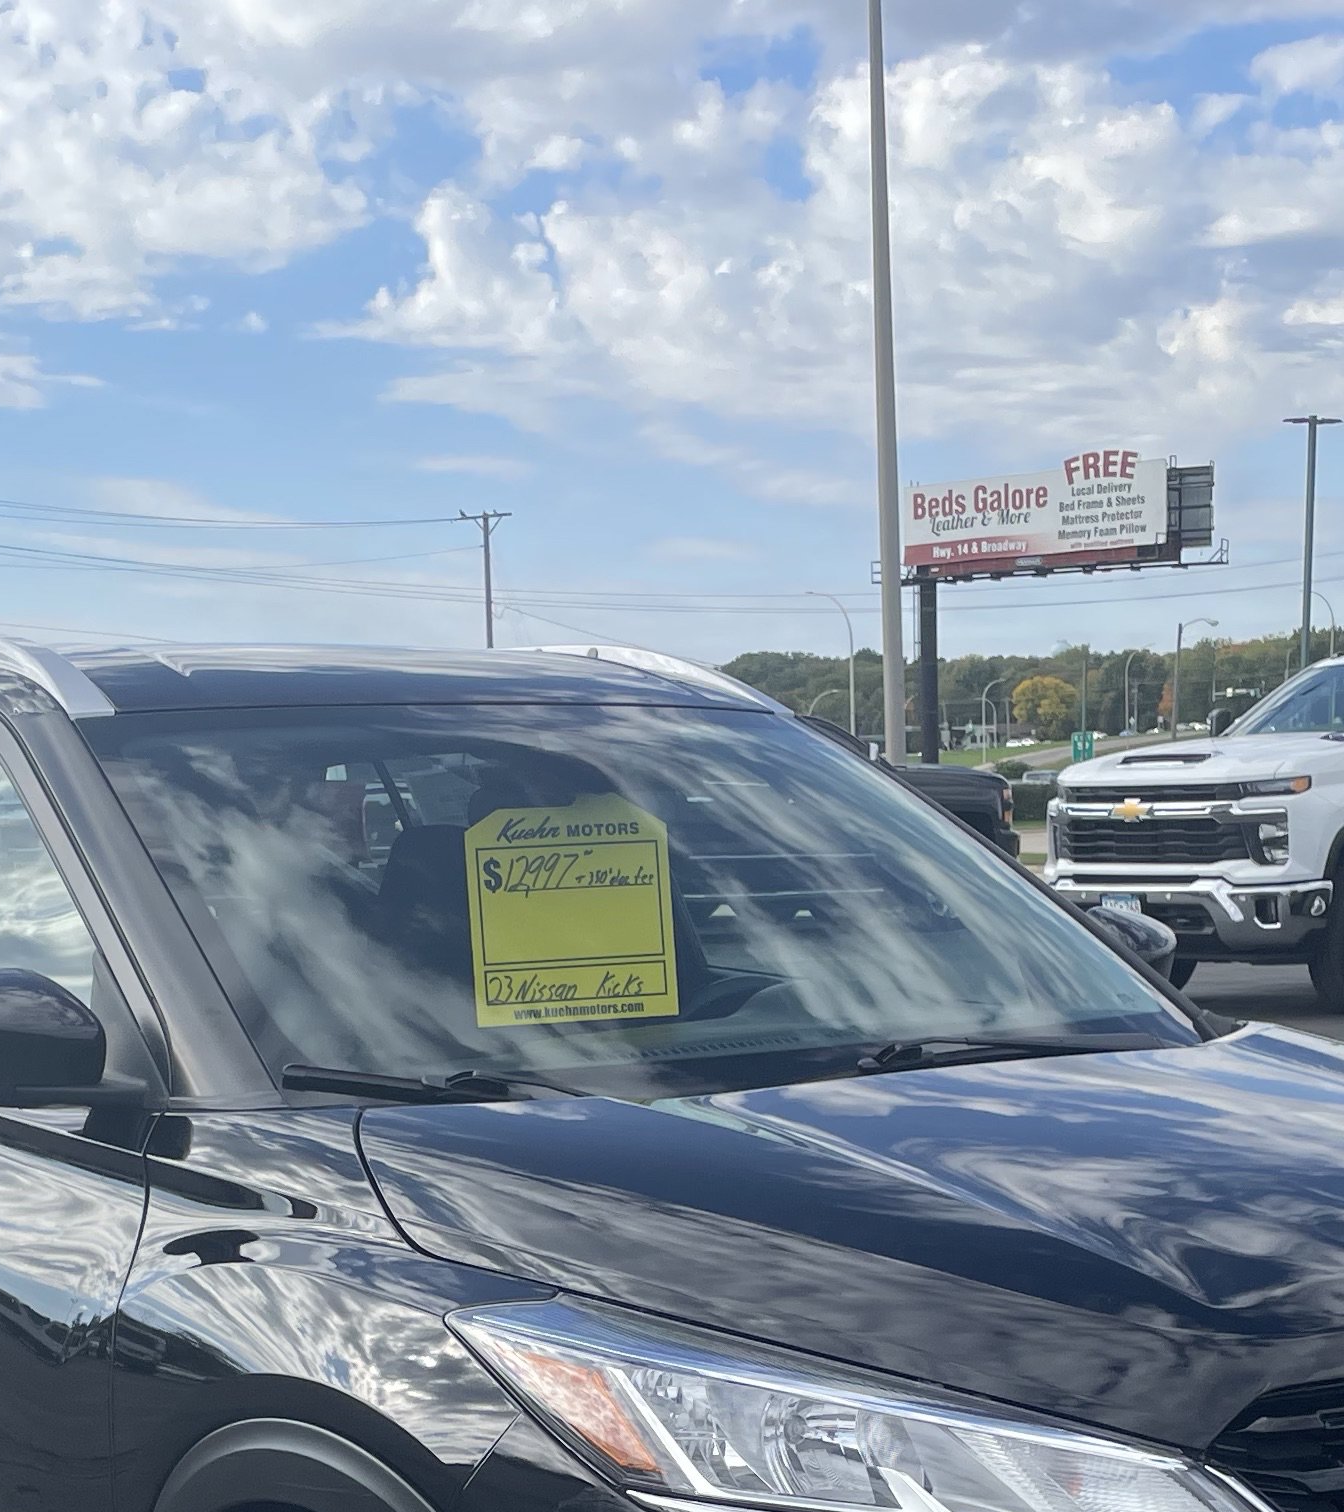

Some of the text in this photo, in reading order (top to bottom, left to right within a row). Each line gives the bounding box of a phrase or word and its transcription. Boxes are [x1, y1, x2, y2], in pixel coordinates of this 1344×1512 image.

[1064, 449, 1138, 486] FREE
[1071, 482, 1132, 497] Local Delivery
[913, 483, 1048, 520] Beds Galore
[1059, 494, 1145, 512] Bed Frame & Sheets
[930, 508, 1031, 536] Leather & More
[1062, 510, 1143, 526] Mattress Protector
[1058, 522, 1147, 540] Memory Foam Pillow
[957, 543, 968, 556] 14
[971, 541, 978, 554] &
[981, 539, 1027, 554] Broadway
[497, 816, 640, 844] Kuehn MOTORS
[488, 971, 644, 1006] 23 Nissan Kicks
[514, 1002, 644, 1020] www.kuehnmotors.com
